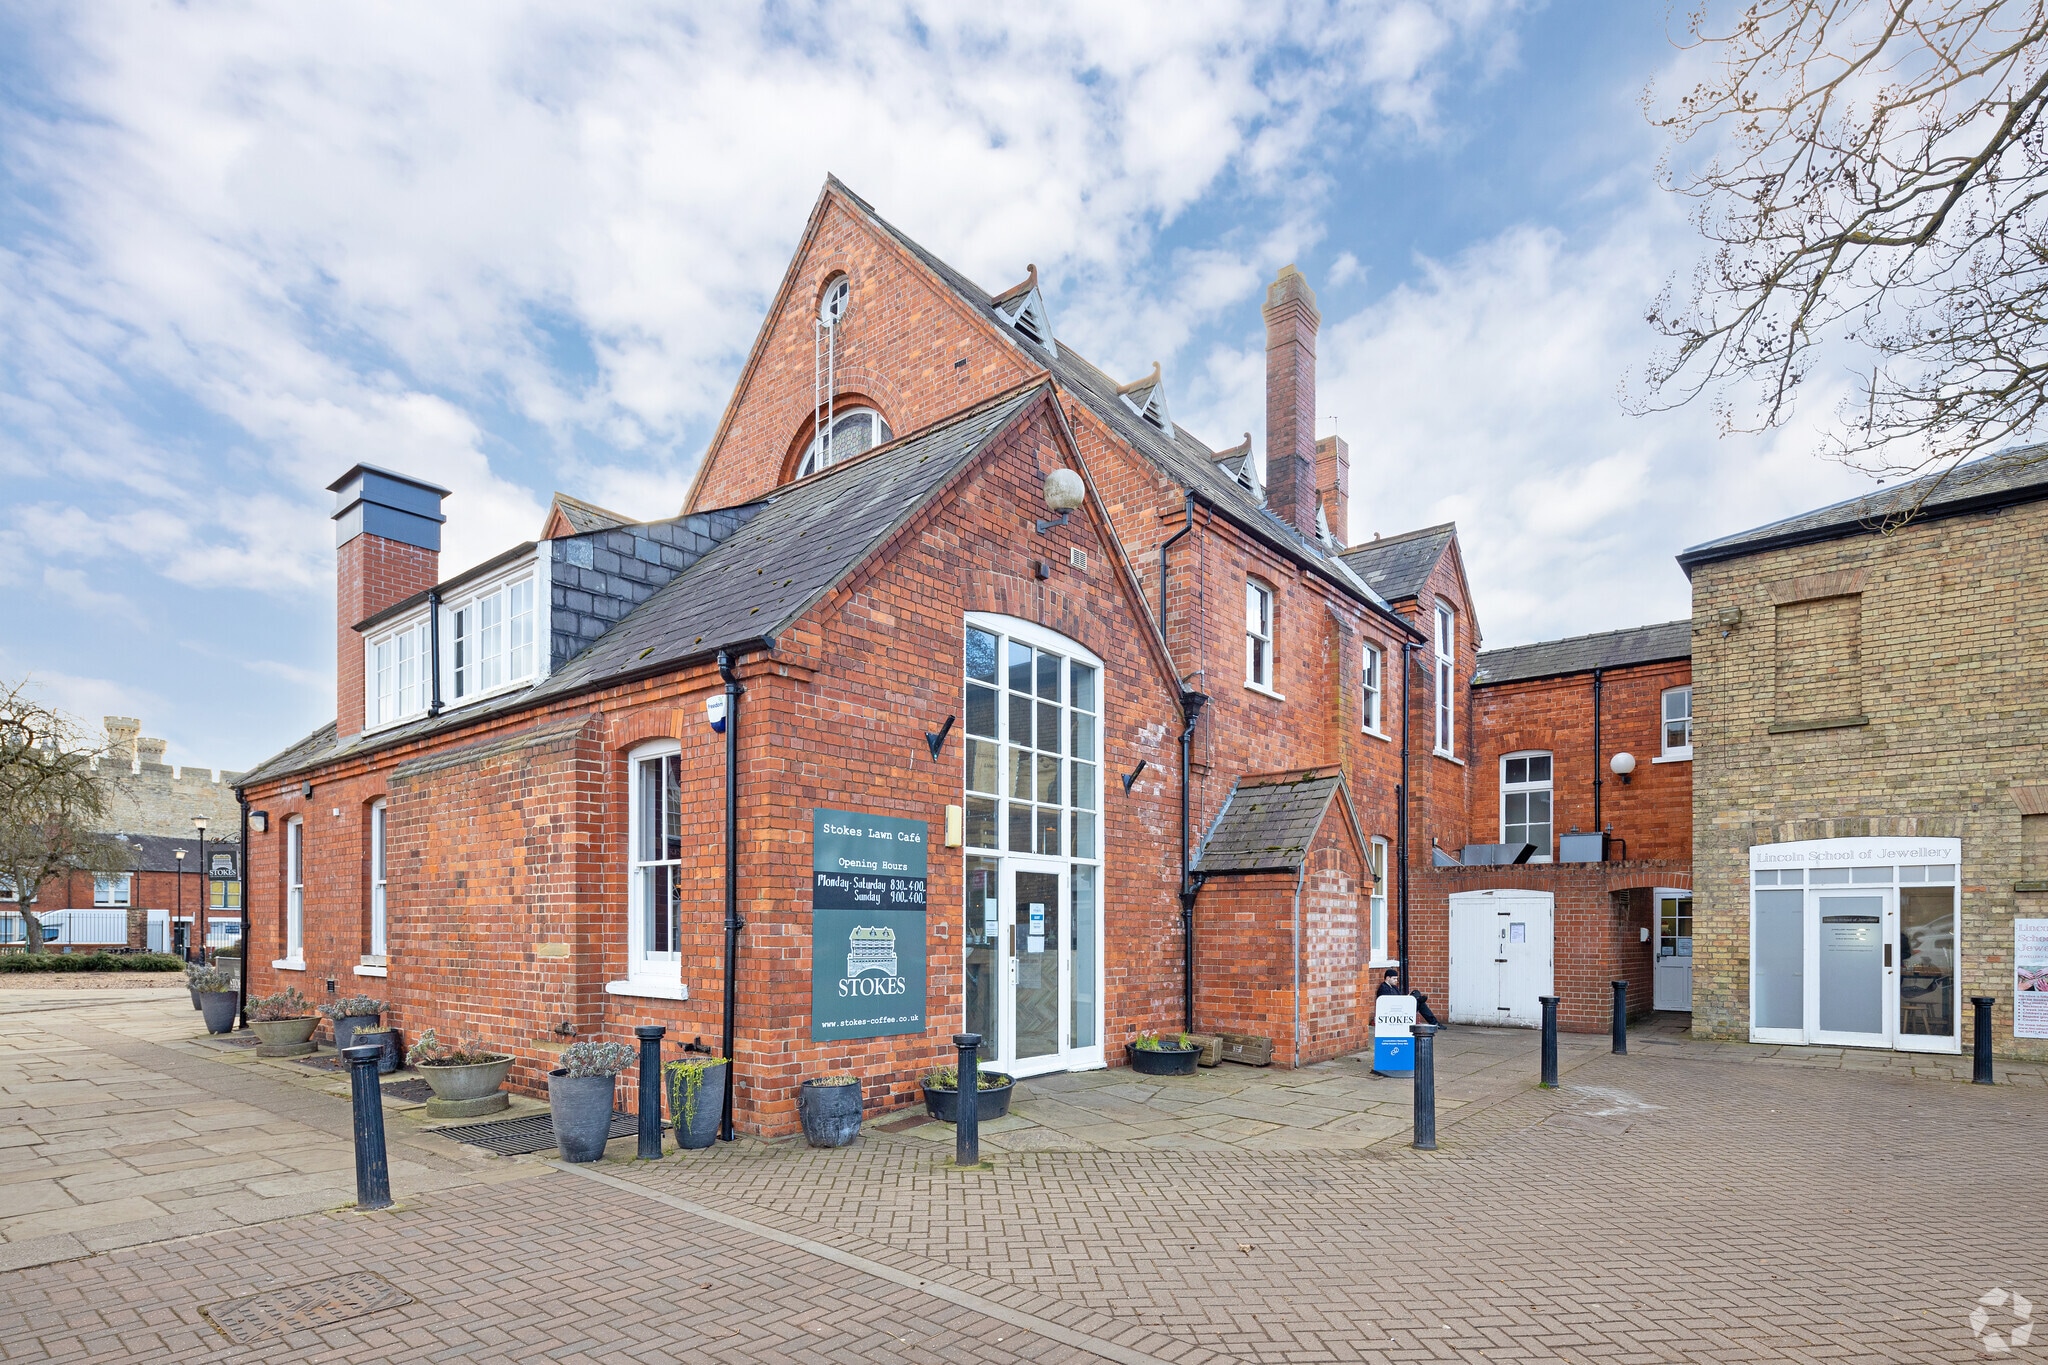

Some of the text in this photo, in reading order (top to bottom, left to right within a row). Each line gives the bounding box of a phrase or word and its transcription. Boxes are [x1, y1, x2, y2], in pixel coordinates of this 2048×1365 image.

[823, 824, 920, 843] Stokes Lawn Café
[1756, 848, 1952, 863] Lincoln School of Jewellery
[839, 858, 908, 871] Opening Hours
[854, 889, 880, 905] Sunday
[838, 977, 906, 997] STOKES
[822, 1014, 919, 1028] www.stokes-coffee.co.uk
[1378, 1016, 1414, 1024] STOKES
